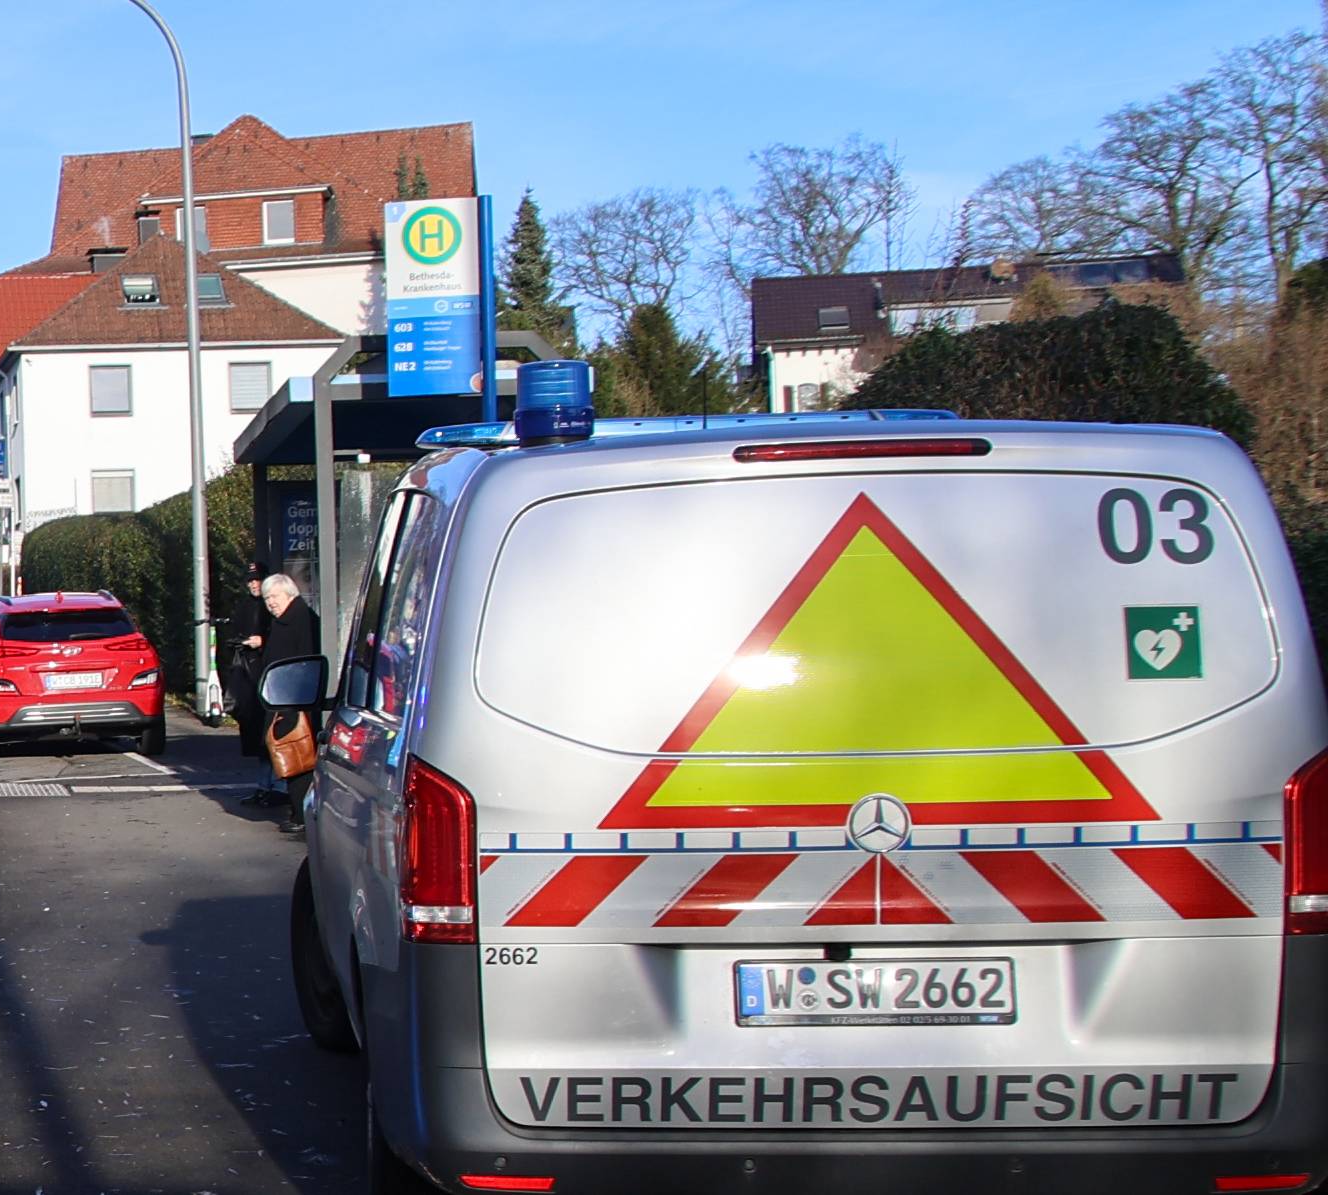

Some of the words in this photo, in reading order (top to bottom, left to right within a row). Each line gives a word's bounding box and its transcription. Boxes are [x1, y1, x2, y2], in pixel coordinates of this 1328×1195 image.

[419, 219, 444, 253] H
[409, 270, 455, 281] Bethesda-
[403, 282, 462, 293] Krankenhaus
[394, 322, 413, 333] 603
[394, 342, 413, 353] 628
[394, 361, 417, 373] NE2
[1098, 487, 1214, 564] 03
[288, 538, 315, 551] Zeit
[485, 947, 538, 965] 2662
[767, 968, 794, 1009] W
[827, 968, 883, 1009] SW
[894, 967, 1006, 1009] 2662
[518, 1073, 1240, 1123] VERKEHRSAUFSICHT
